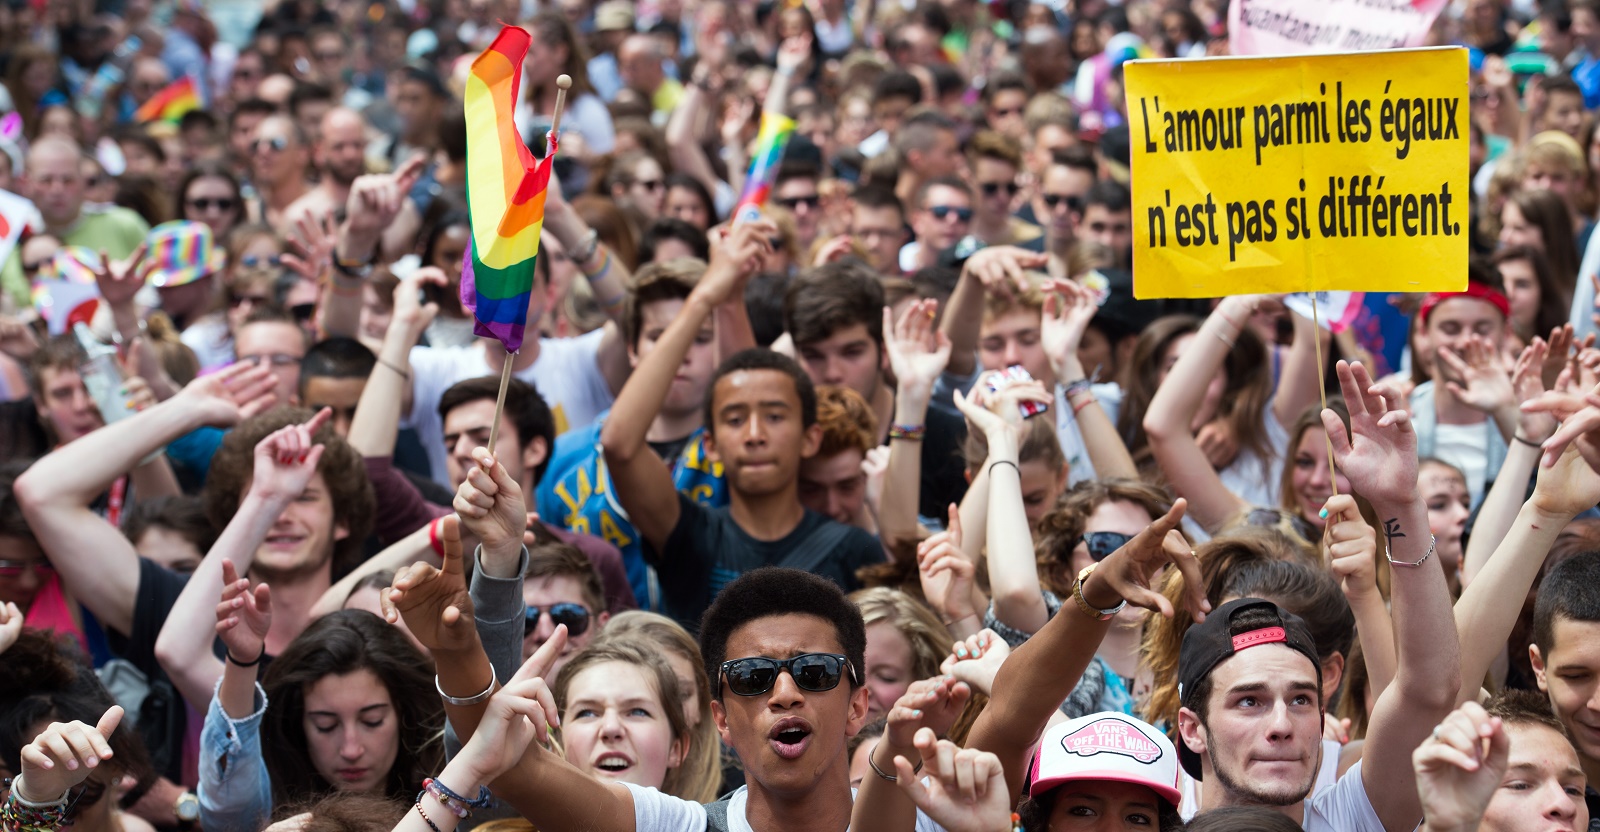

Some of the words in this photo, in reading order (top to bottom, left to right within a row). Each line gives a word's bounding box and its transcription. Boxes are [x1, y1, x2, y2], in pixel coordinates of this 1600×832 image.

[1140, 95, 1245, 153] L'amour
[1253, 82, 1331, 166] parmi
[1336, 81, 1372, 143] les
[1380, 79, 1459, 160] égaux
[1148, 189, 1219, 248] n'est
[1226, 199, 1278, 262] pas
[1285, 178, 1311, 240] si
[1318, 175, 1460, 238] différent.
[1092, 723, 1129, 735] VANS
[1096, 733, 1123, 749] THE
